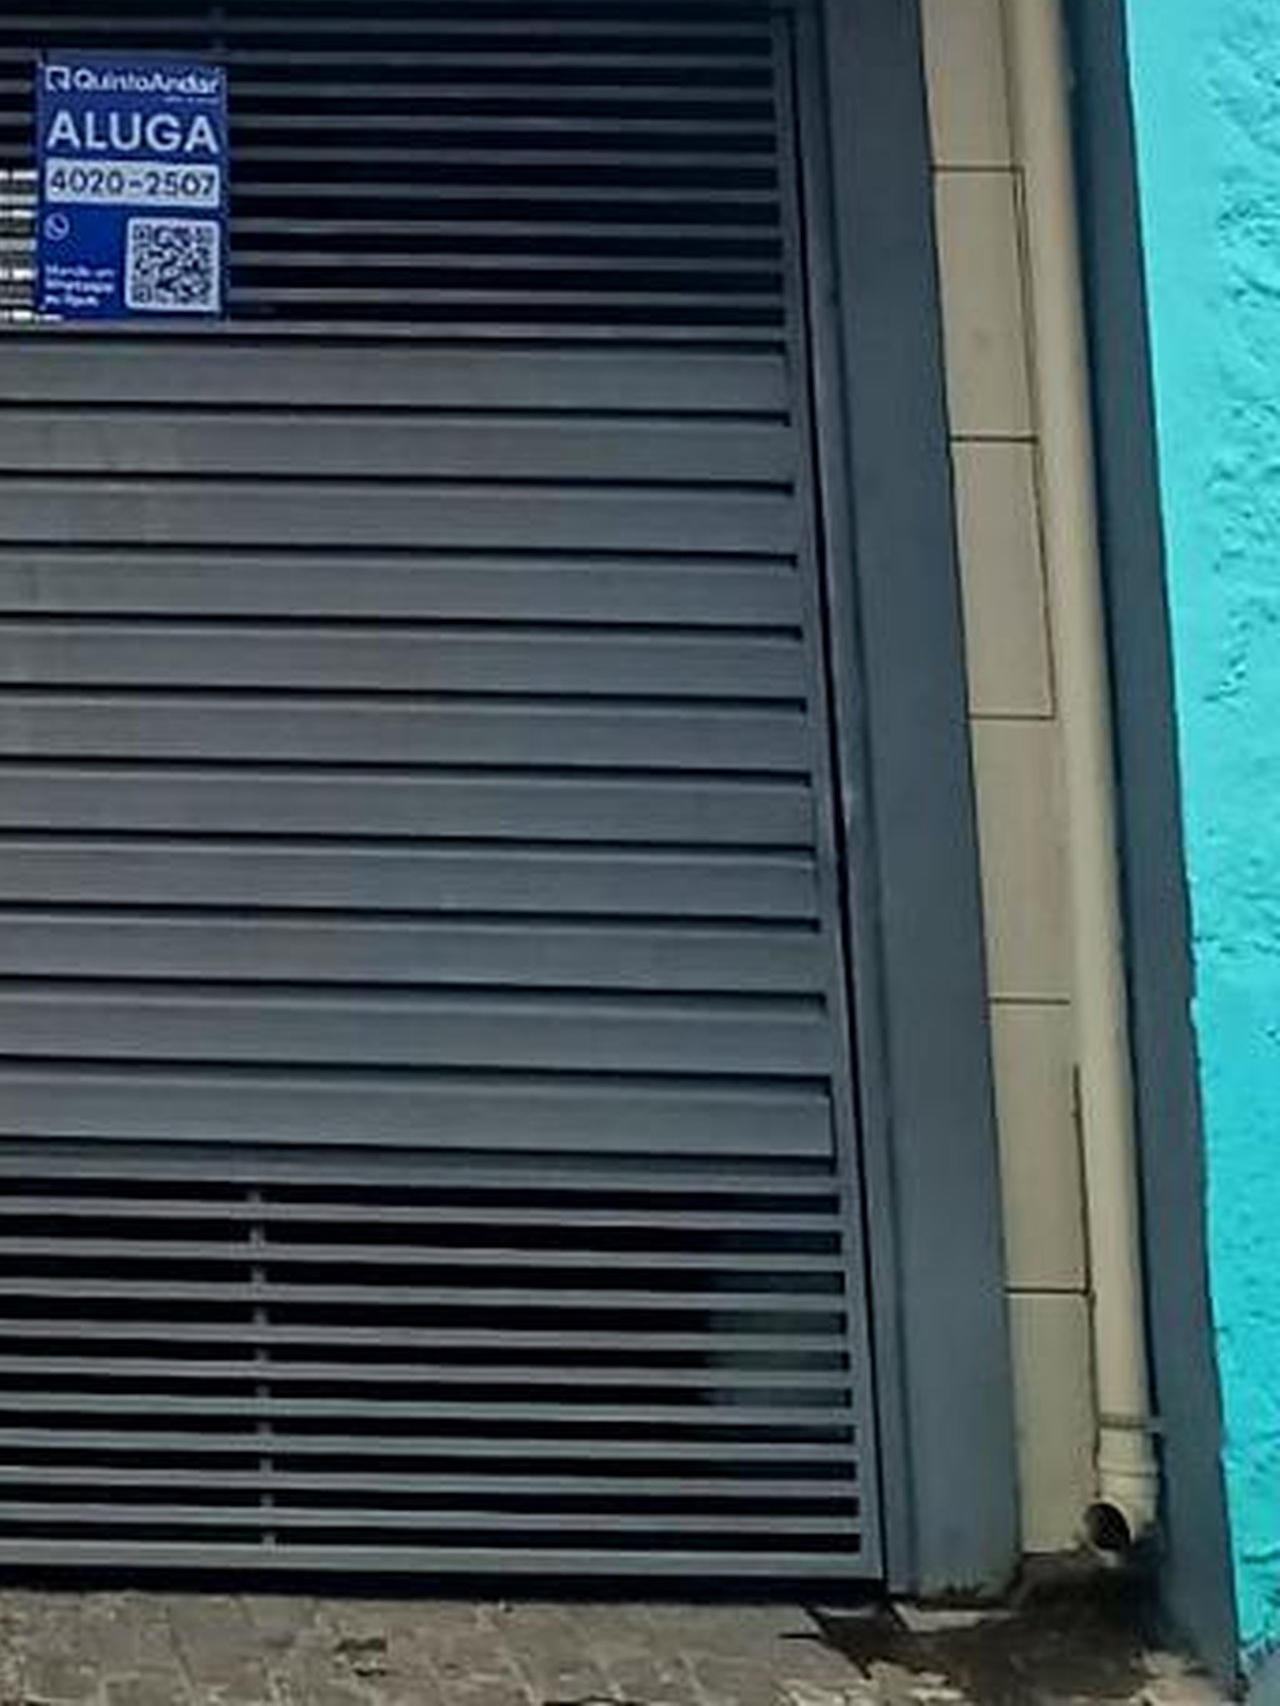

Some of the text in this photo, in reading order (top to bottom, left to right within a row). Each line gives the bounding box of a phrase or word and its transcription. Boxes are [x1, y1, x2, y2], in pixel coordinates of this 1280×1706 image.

[73, 69, 219, 94] QuintoAndar
[46, 110, 219, 154] ALUGA
[50, 167, 216, 197] 4020-2507
